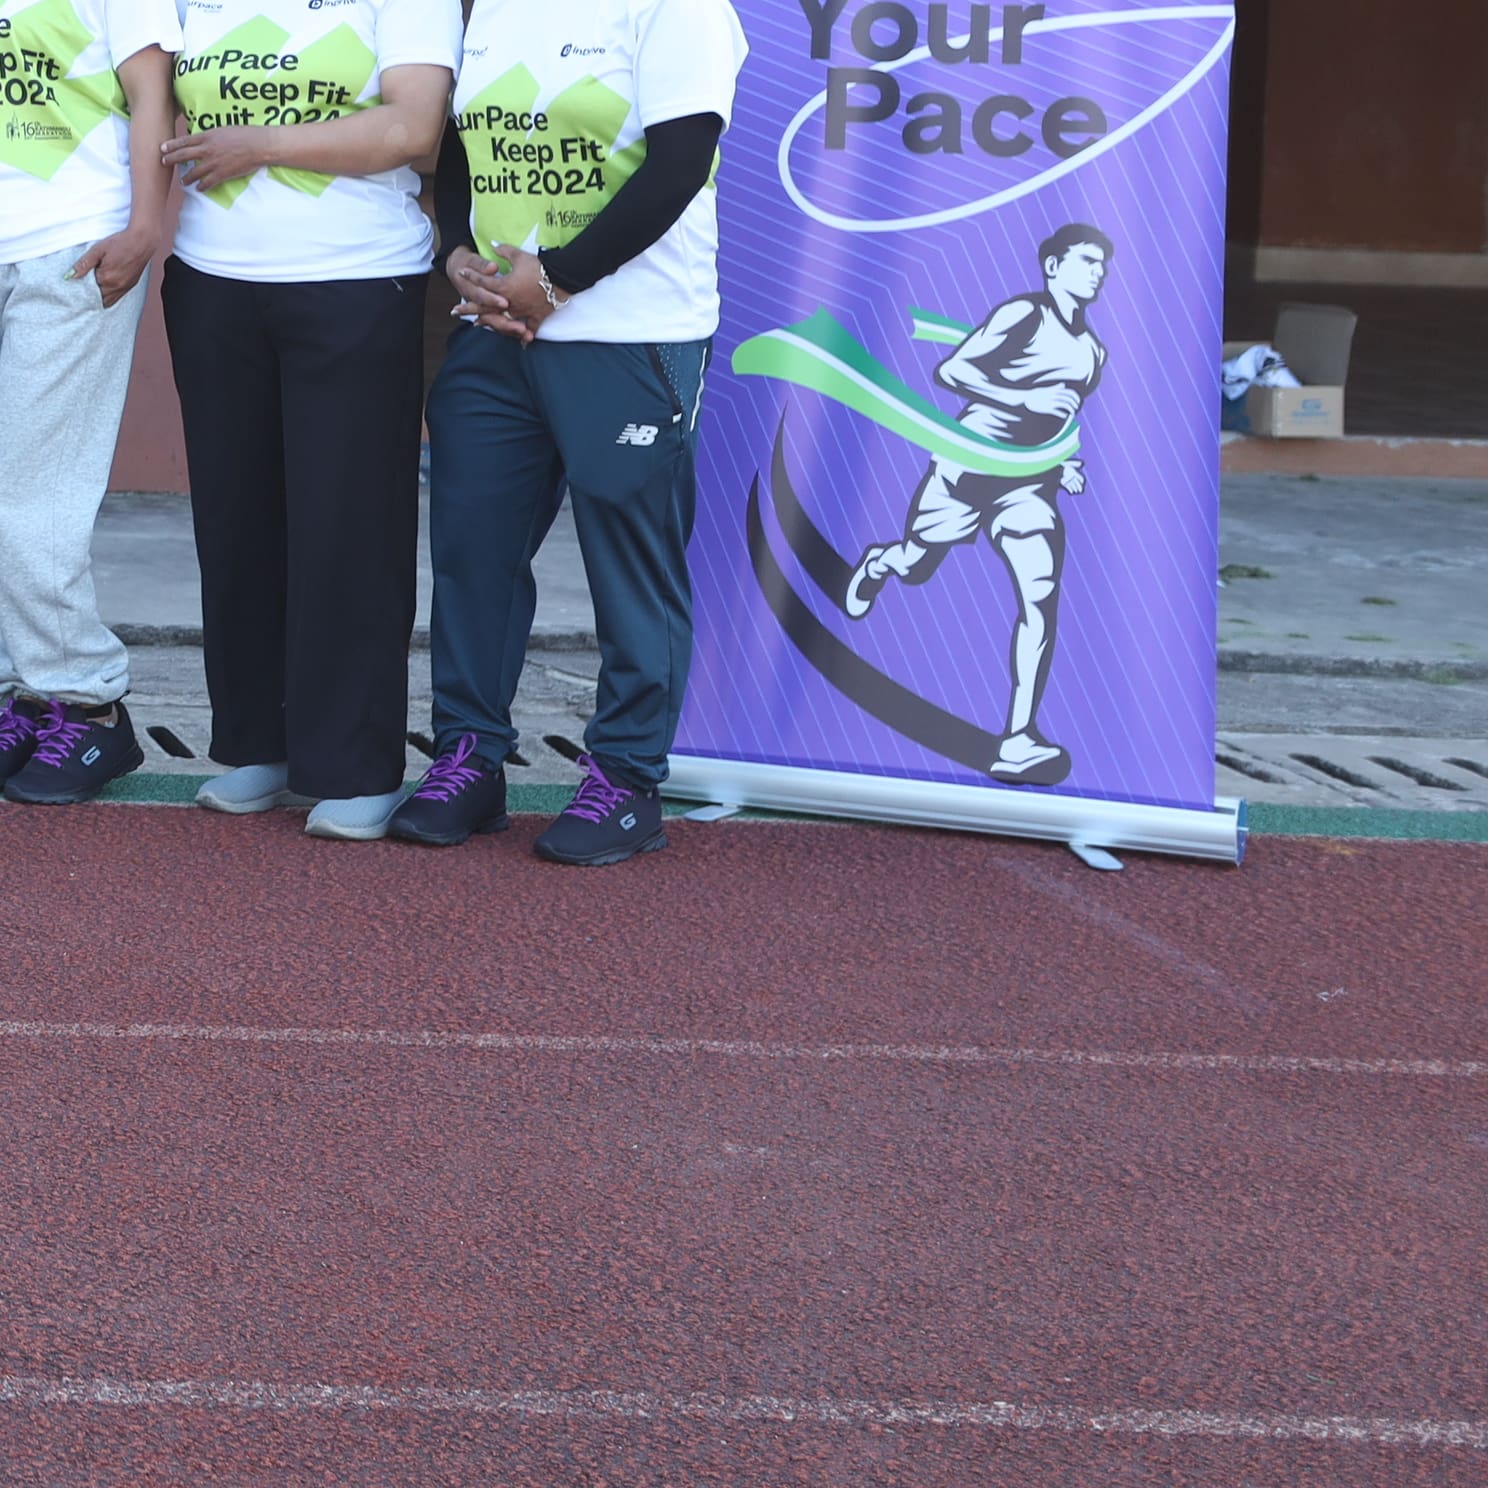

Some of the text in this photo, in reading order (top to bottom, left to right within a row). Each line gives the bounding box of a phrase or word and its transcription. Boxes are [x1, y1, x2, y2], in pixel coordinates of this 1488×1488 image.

[20, 48, 61, 80] Fit
[219, 76, 351, 106] Keep Fit
[824, 67, 1108, 159] Pace
[491, 137, 606, 169] Keep Fit
[527, 168, 606, 195] 2024
